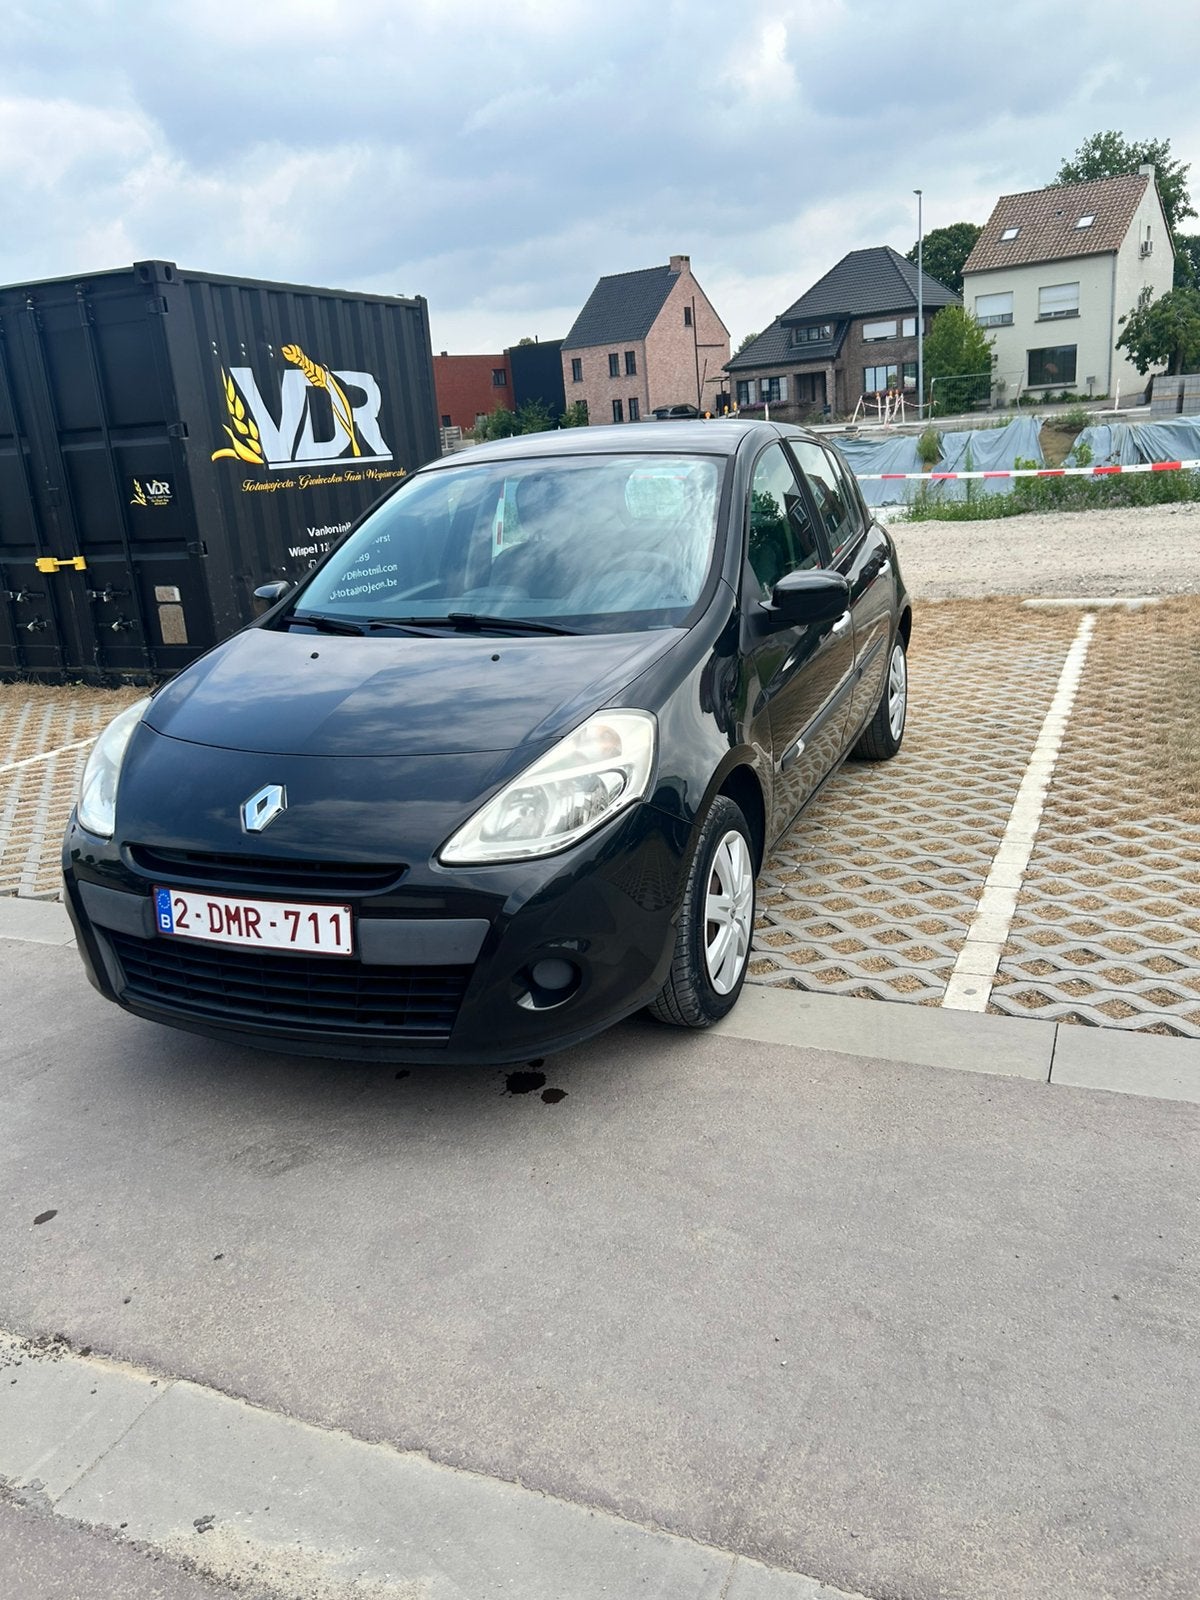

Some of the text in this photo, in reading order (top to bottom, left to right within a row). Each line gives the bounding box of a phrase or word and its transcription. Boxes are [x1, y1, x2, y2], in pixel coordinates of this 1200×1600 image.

[229, 366, 392, 463] VDR
[146, 481, 171, 495] VDR
[161, 897, 341, 946] B 2-DMR-711
